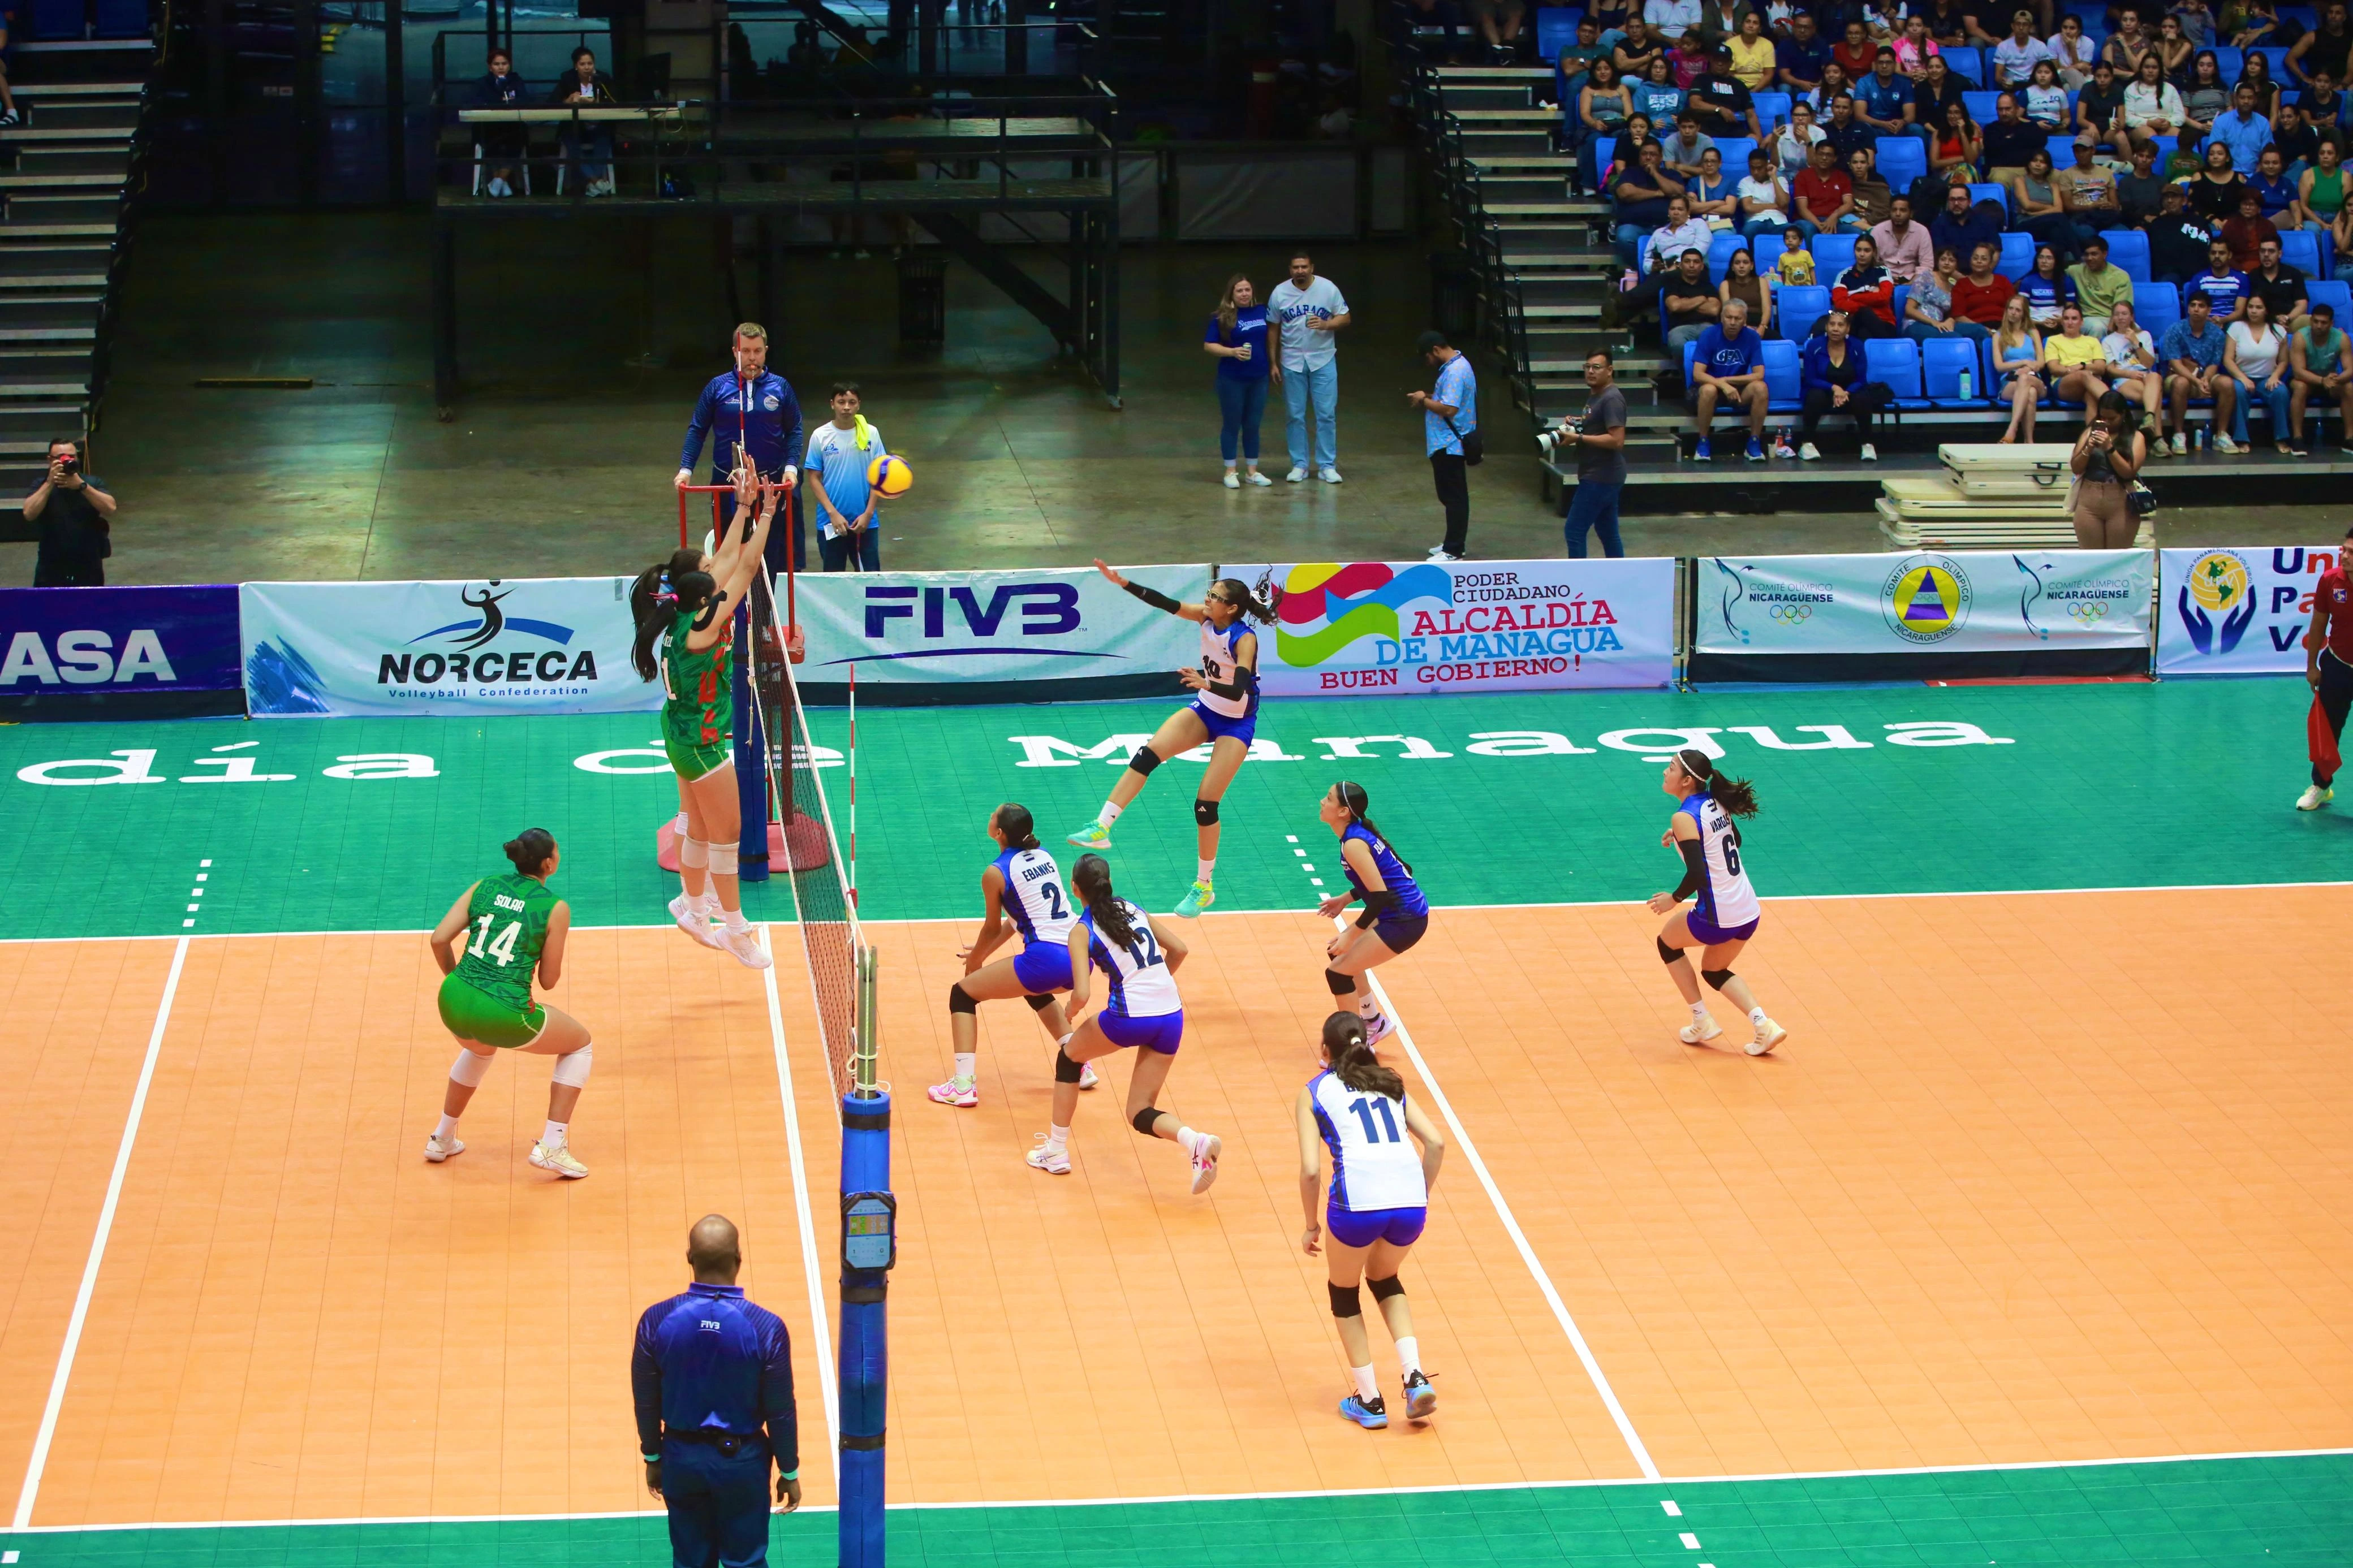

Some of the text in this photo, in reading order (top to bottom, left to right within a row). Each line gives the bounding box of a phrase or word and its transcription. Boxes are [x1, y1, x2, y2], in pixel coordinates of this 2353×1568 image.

[1454, 572, 1519, 588] PODER
[2185, 564, 2195, 583] UNION
[1453, 585, 1571, 603] CIUDADANO
[1749, 582, 1833, 591] COMITÉ OLÍMPICO
[2047, 589, 2129, 600] NICARAGÜENSE
[1749, 593, 1833, 602] NICARAGÜENSE
[864, 582, 1081, 638] FIVB
[1411, 593, 1618, 636] ALCALDÍA
[1895, 623, 1958, 642] NICARAGUENSE
[1376, 627, 1623, 666] DE MANAGUA
[377, 651, 598, 684] NORCECA
[1320, 668, 1398, 690] BUEN
[389, 686, 588, 698] Volleyball Confederation
[1008, 721, 2016, 767] Managua
[1709, 813, 1731, 833] VARGAS
[1722, 834, 1741, 876] 6
[1022, 862, 1055, 882] EBANKS
[494, 895, 525, 913] SOLAR
[1041, 882, 1068, 919] 2
[468, 913, 523, 967] 14
[1127, 927, 1164, 970] 12
[1348, 1097, 1401, 1143] 11
[700, 1320, 721, 1329] FIVB
